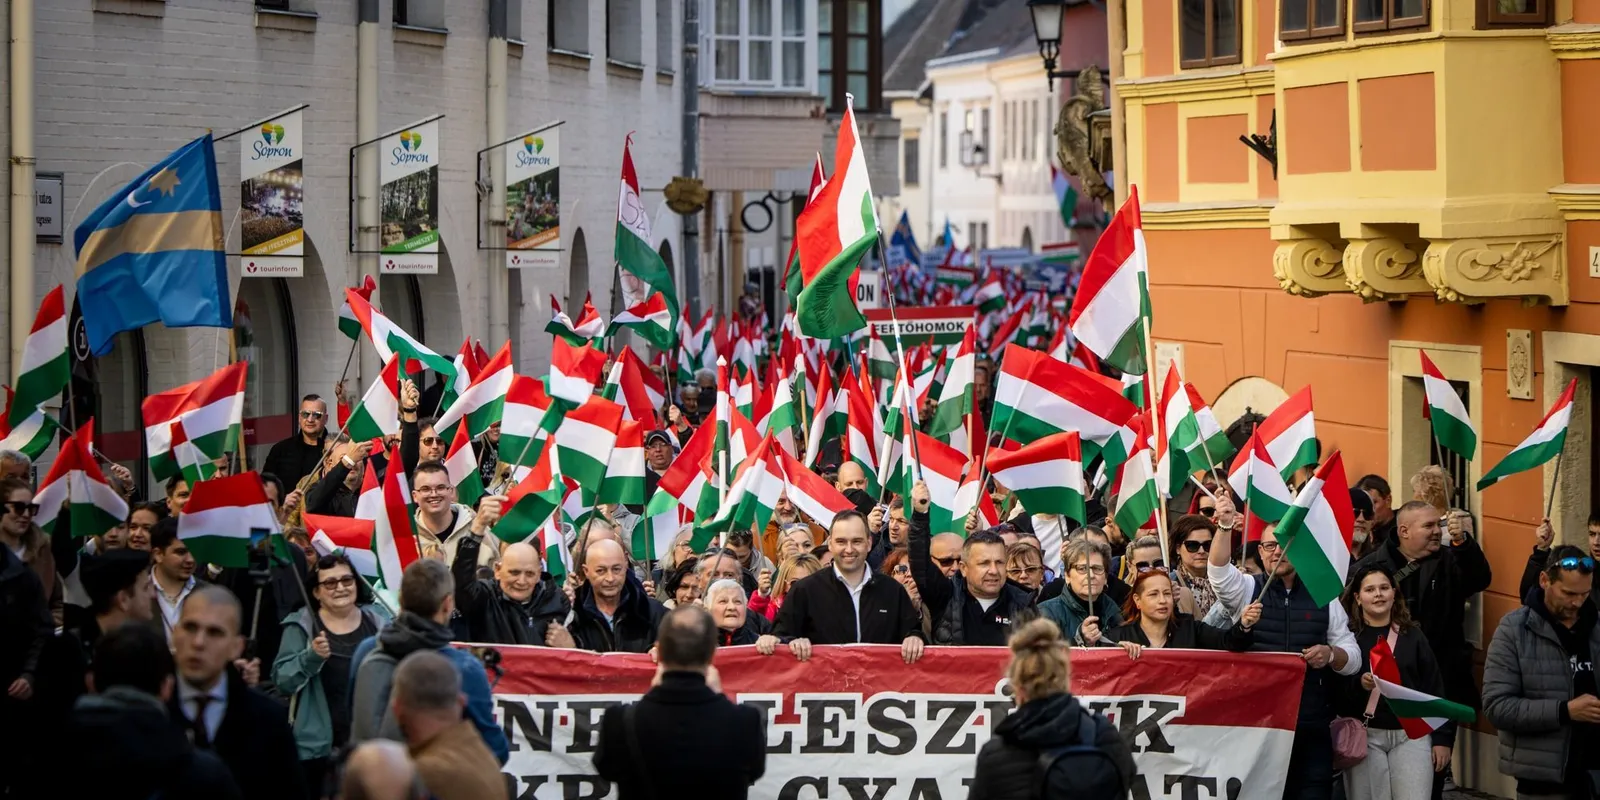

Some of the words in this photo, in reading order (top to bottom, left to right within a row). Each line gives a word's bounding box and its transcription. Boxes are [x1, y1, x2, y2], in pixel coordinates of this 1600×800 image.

[251, 140, 292, 160] Sopron
[390, 147, 429, 166] Sopron
[515, 150, 551, 168] Sopron
[857, 284, 874, 302] ON
[497, 700, 641, 753] NE
[743, 684, 1180, 756] LESZK
